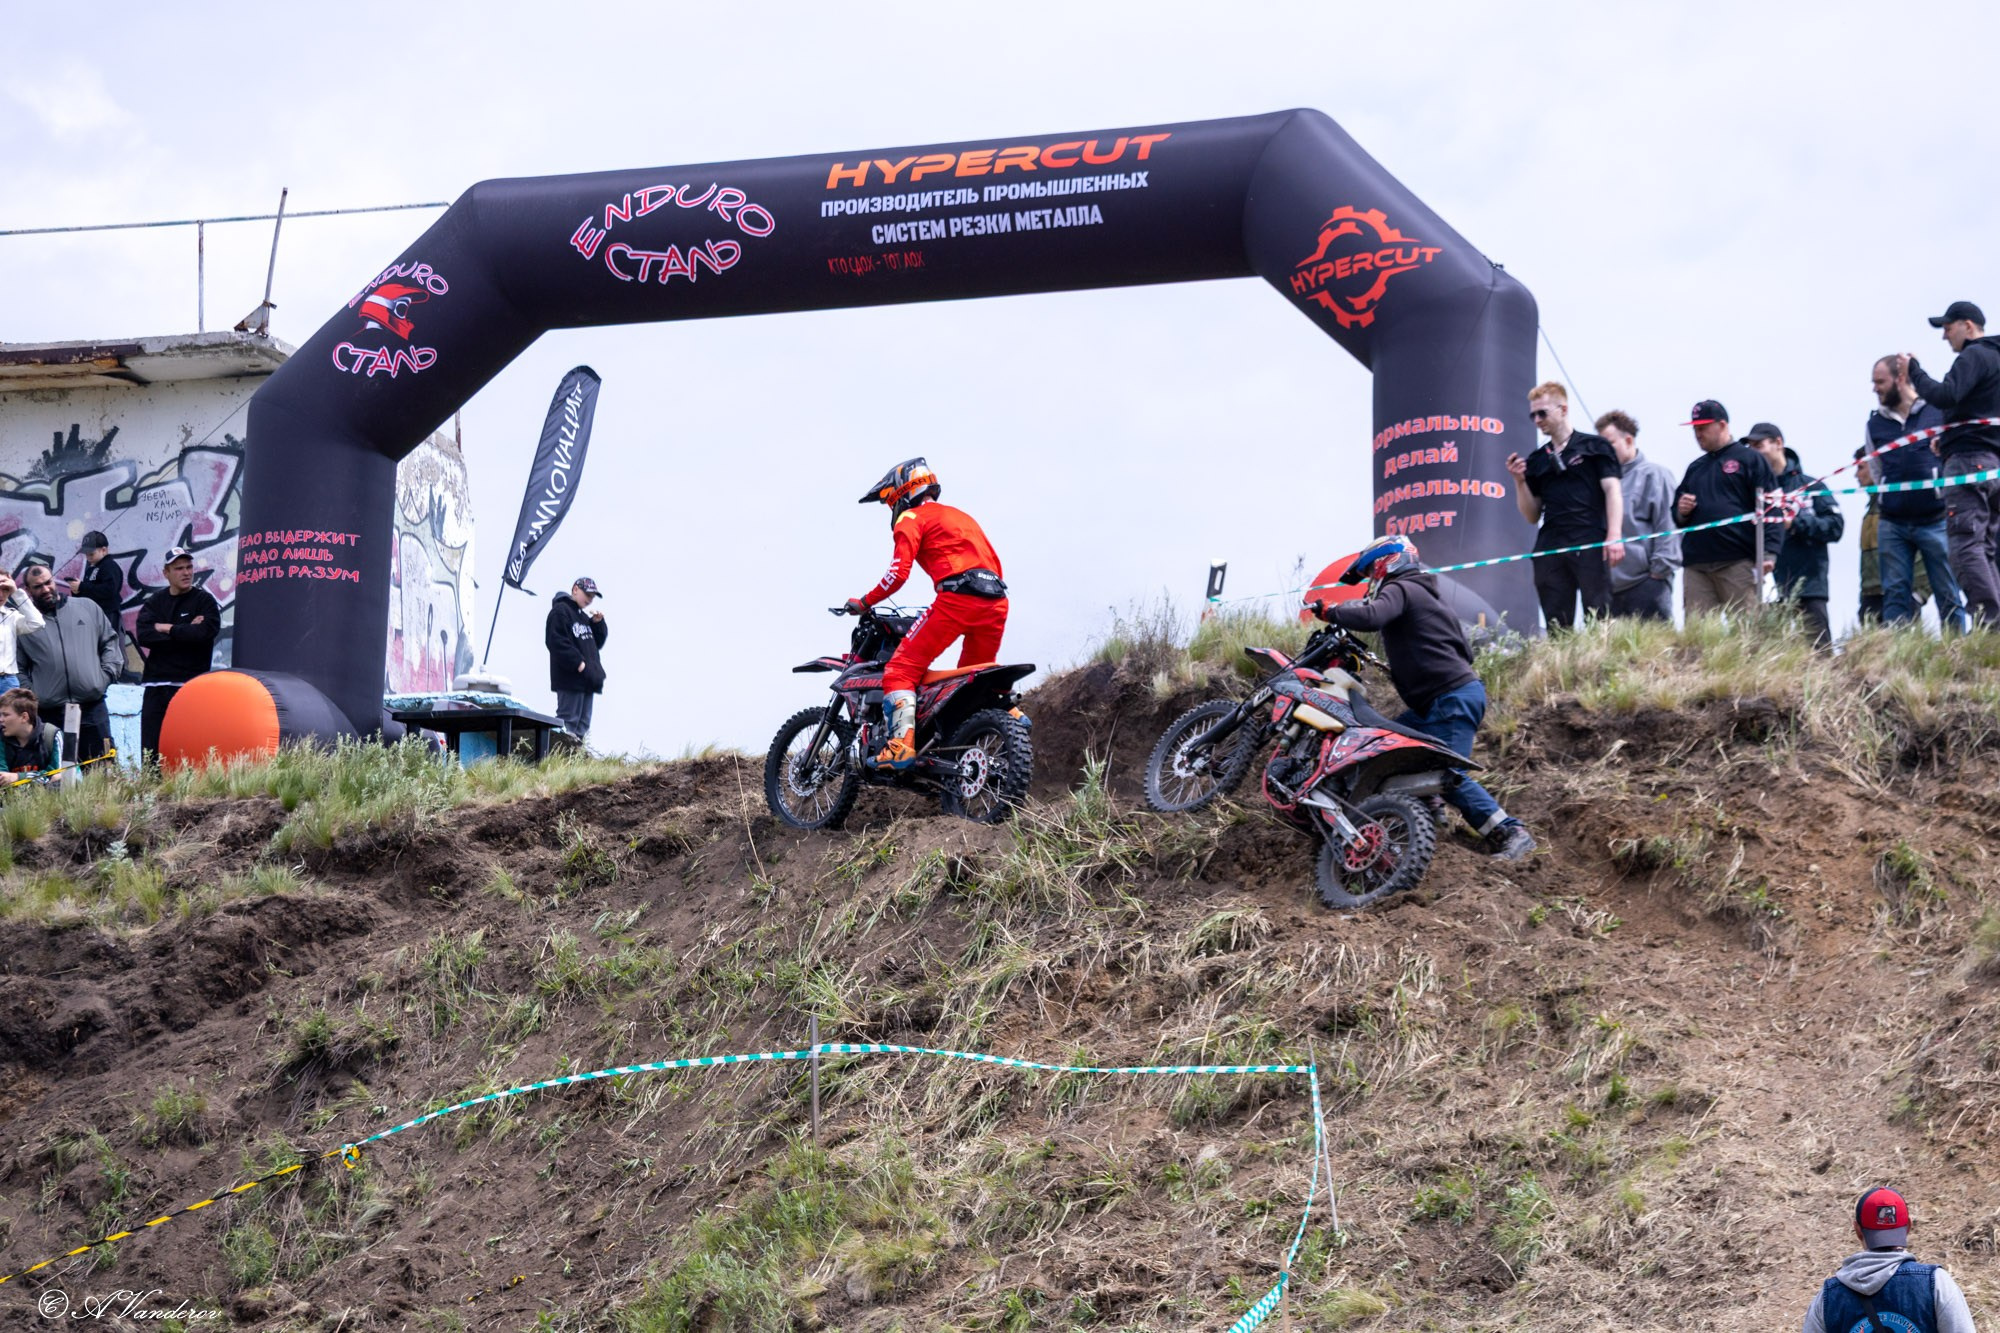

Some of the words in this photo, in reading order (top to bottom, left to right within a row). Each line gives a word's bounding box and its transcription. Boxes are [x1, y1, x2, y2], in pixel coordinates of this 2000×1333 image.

[826, 133, 1172, 189] HYPERCUT
[821, 187, 979, 218] ПРОИЗВОДИТЕЛЬ
[983, 171, 1150, 202] ПРОМЫШЛЕННЫХ
[571, 182, 776, 260] ENDURO
[871, 218, 947, 245] СИСТЕМ
[949, 212, 1012, 238] РЕЗКИ
[1014, 204, 1104, 232] МЕТАЛЛА
[604, 239, 742, 285] СТАЛЬ
[827, 256, 848, 275] КТО
[848, 254, 877, 278] СДОХ
[881, 251, 901, 271] ТОТ
[903, 249, 926, 269] ЛОХ
[1289, 247, 1443, 295] HYPERCUT
[332, 341, 438, 379] СТАЛЬ
[1373, 415, 1504, 455] ормально
[1384, 440, 1459, 479] делай
[1373, 479, 1506, 518] ормально
[264, 529, 361, 547] ВЫДЕРЖИТ
[1385, 511, 1457, 537] будет
[243, 548, 279, 566] НАДО
[282, 547, 334, 562] ЛИШЬ
[288, 565, 360, 583] РАЗУМ
[1309, 690, 1332, 710] Red
[1327, 703, 1348, 719] Bull
